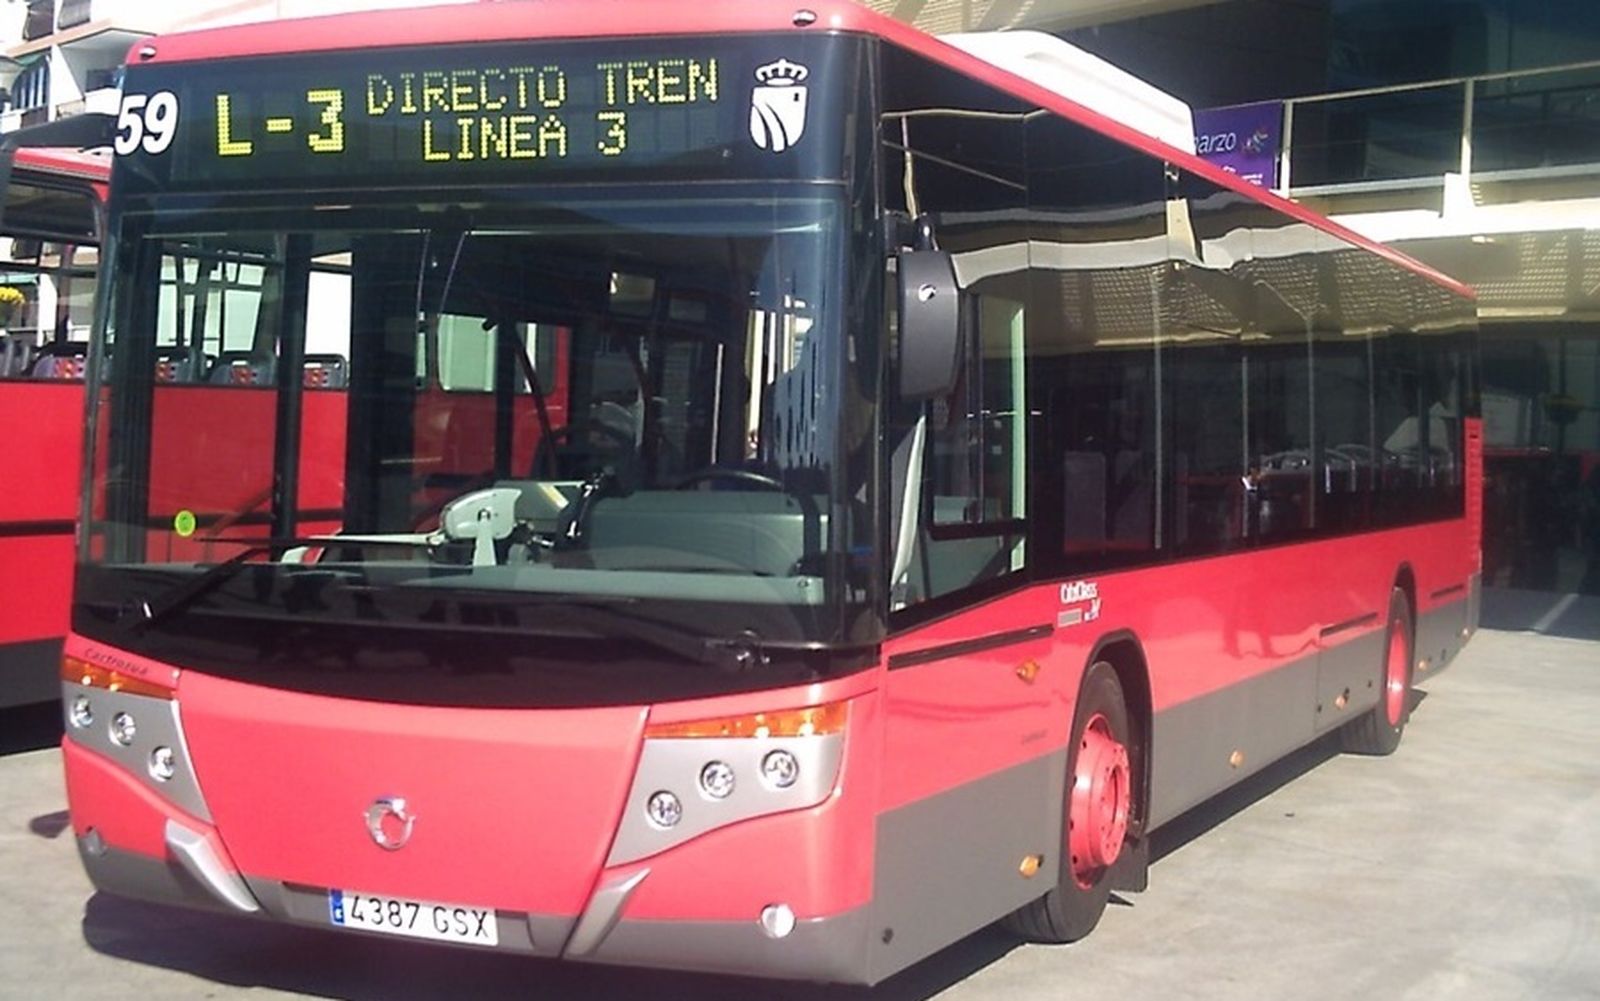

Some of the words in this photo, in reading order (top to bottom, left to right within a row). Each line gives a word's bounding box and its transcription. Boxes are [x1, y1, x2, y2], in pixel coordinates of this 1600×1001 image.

[366, 66, 567, 115] DIRECTO
[597, 58, 718, 104] TREN
[114, 91, 178, 155] 59
[423, 114, 567, 161] LINEA
[598, 112, 626, 156] 3
[1195, 132, 1236, 153] arzo
[351, 896, 420, 929] 4387
[432, 906, 489, 938] GSX
